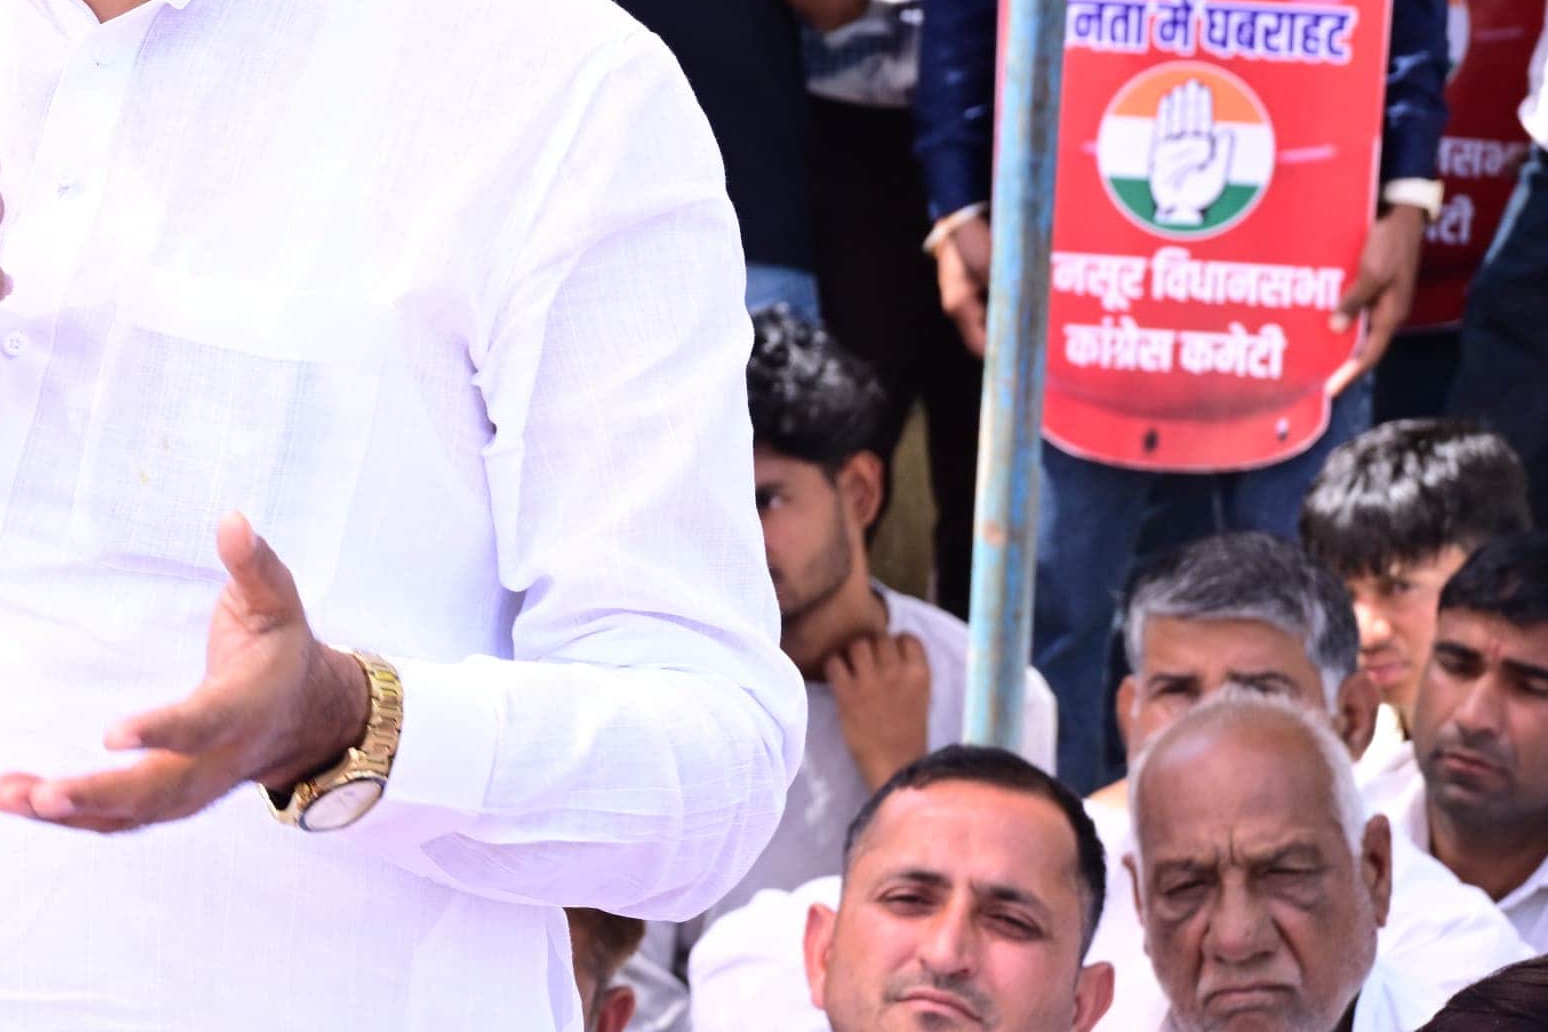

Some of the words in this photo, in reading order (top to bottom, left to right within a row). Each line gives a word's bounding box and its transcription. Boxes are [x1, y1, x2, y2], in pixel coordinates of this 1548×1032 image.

[1206, 4, 1351, 58] घबराहट
[1050, 251, 1148, 313] नसूर
[1150, 245, 1345, 312] विधानसभा
[1062, 314, 1177, 374] कांग्रेस
[1179, 321, 1288, 381] कमेटी
